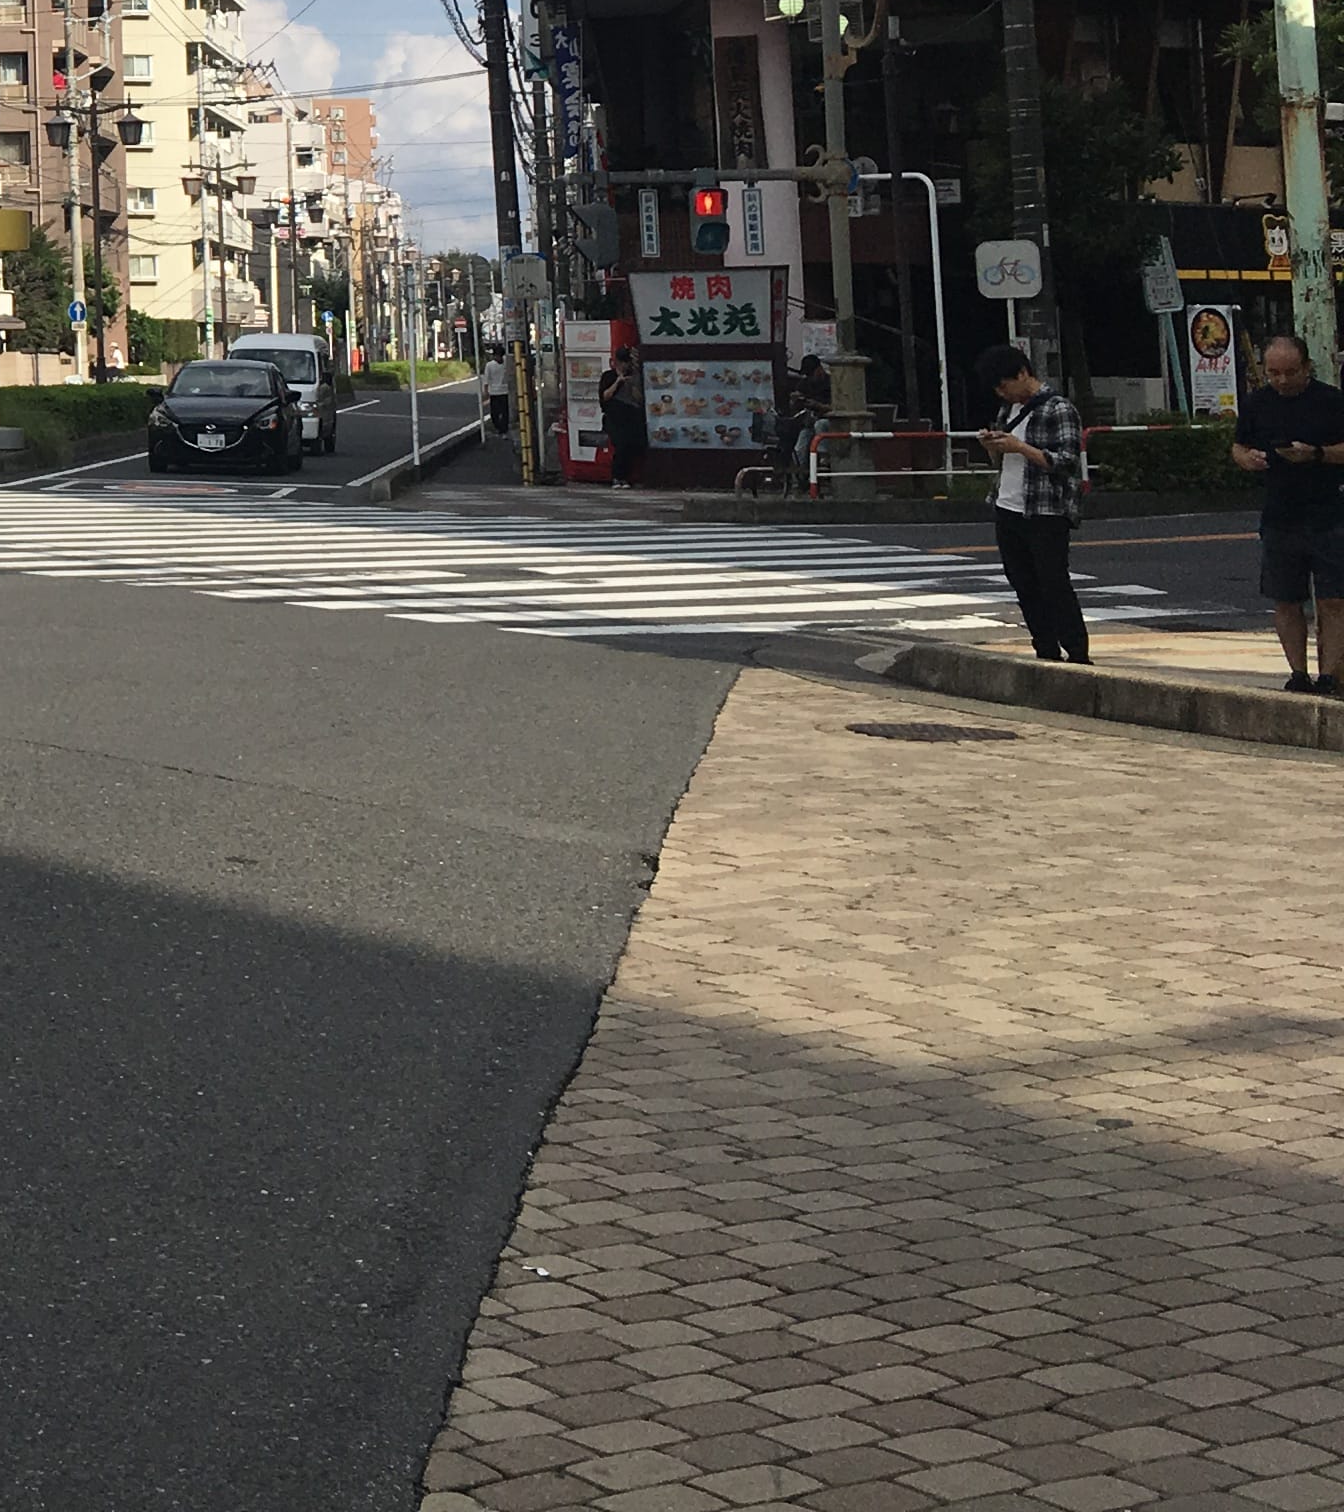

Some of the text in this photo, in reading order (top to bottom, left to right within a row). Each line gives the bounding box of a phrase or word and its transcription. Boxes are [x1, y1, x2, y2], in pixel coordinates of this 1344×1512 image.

[670, 274, 733, 300] 焼肉
[649, 302, 761, 337] 太光苑
